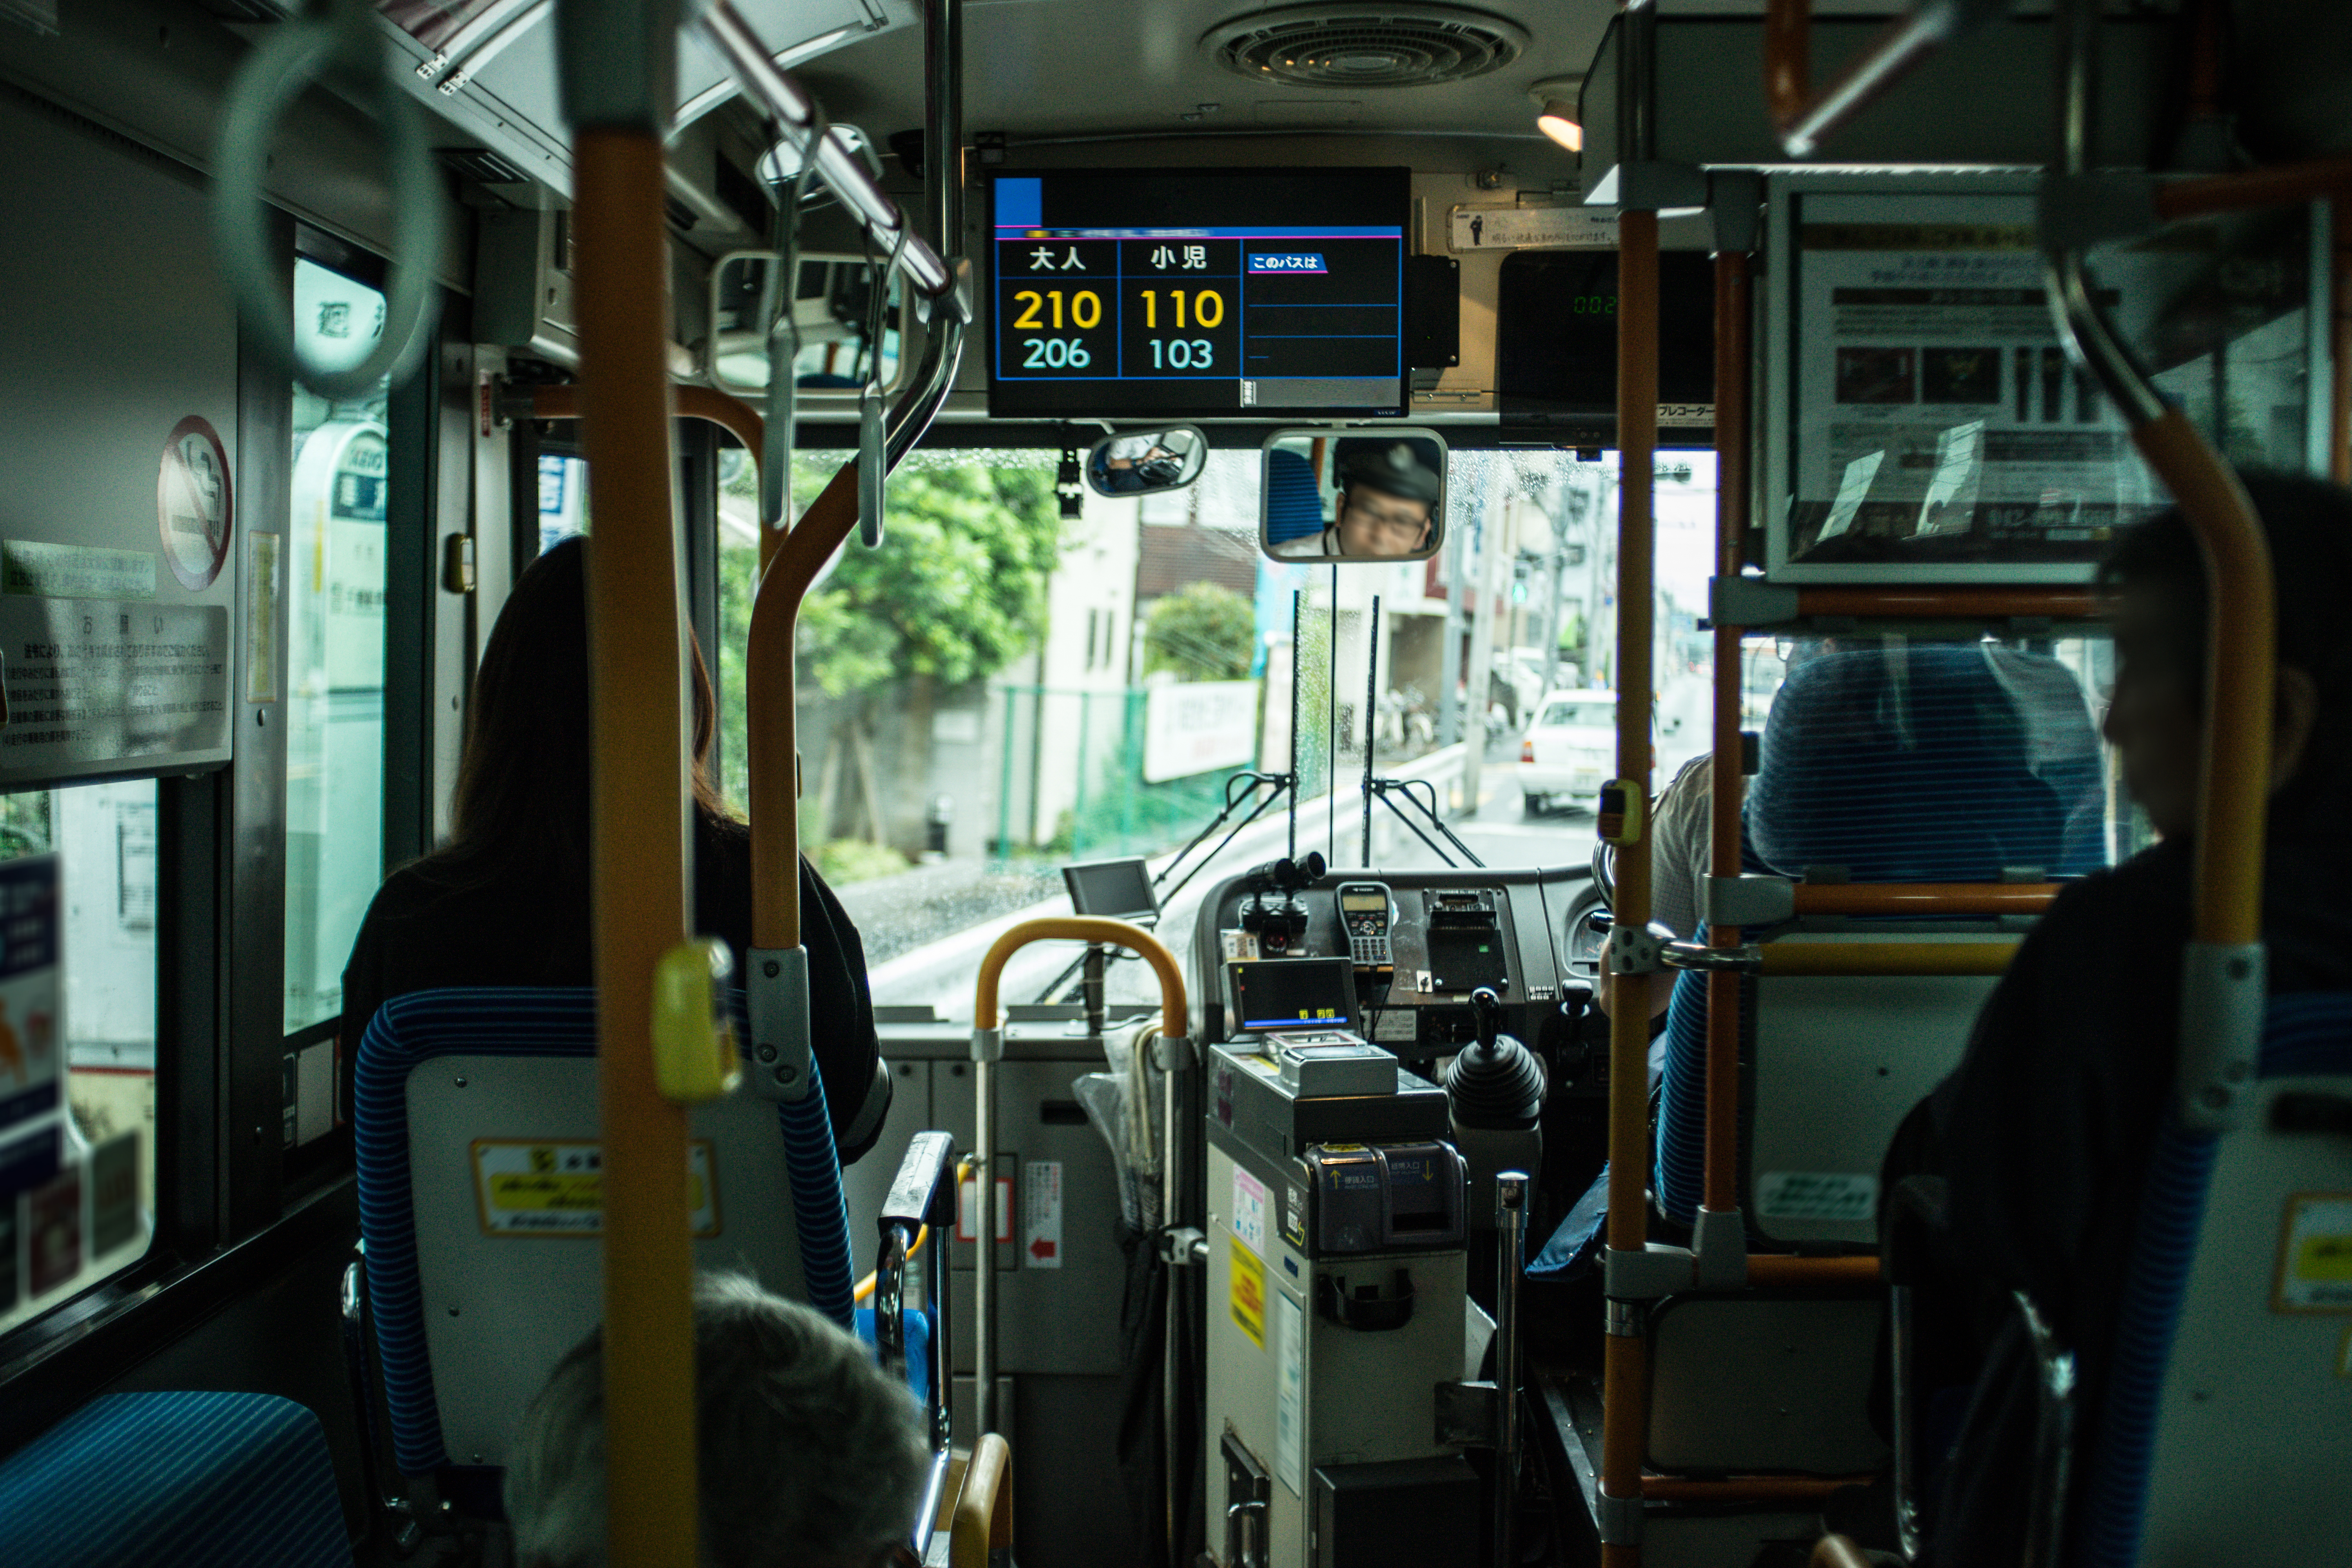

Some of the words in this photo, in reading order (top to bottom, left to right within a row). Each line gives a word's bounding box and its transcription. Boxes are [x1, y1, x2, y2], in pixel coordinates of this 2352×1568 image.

[1030, 246, 1086, 270] 大人
[1151, 245, 1207, 269] 小児
[1254, 256, 1318, 269] このバスは
[1014, 290, 1102, 329] 210
[1141, 290, 1224, 328] 110
[1573, 296, 1617, 314] 002
[1023, 338, 1091, 369] 206
[1150, 339, 1214, 369] 103
